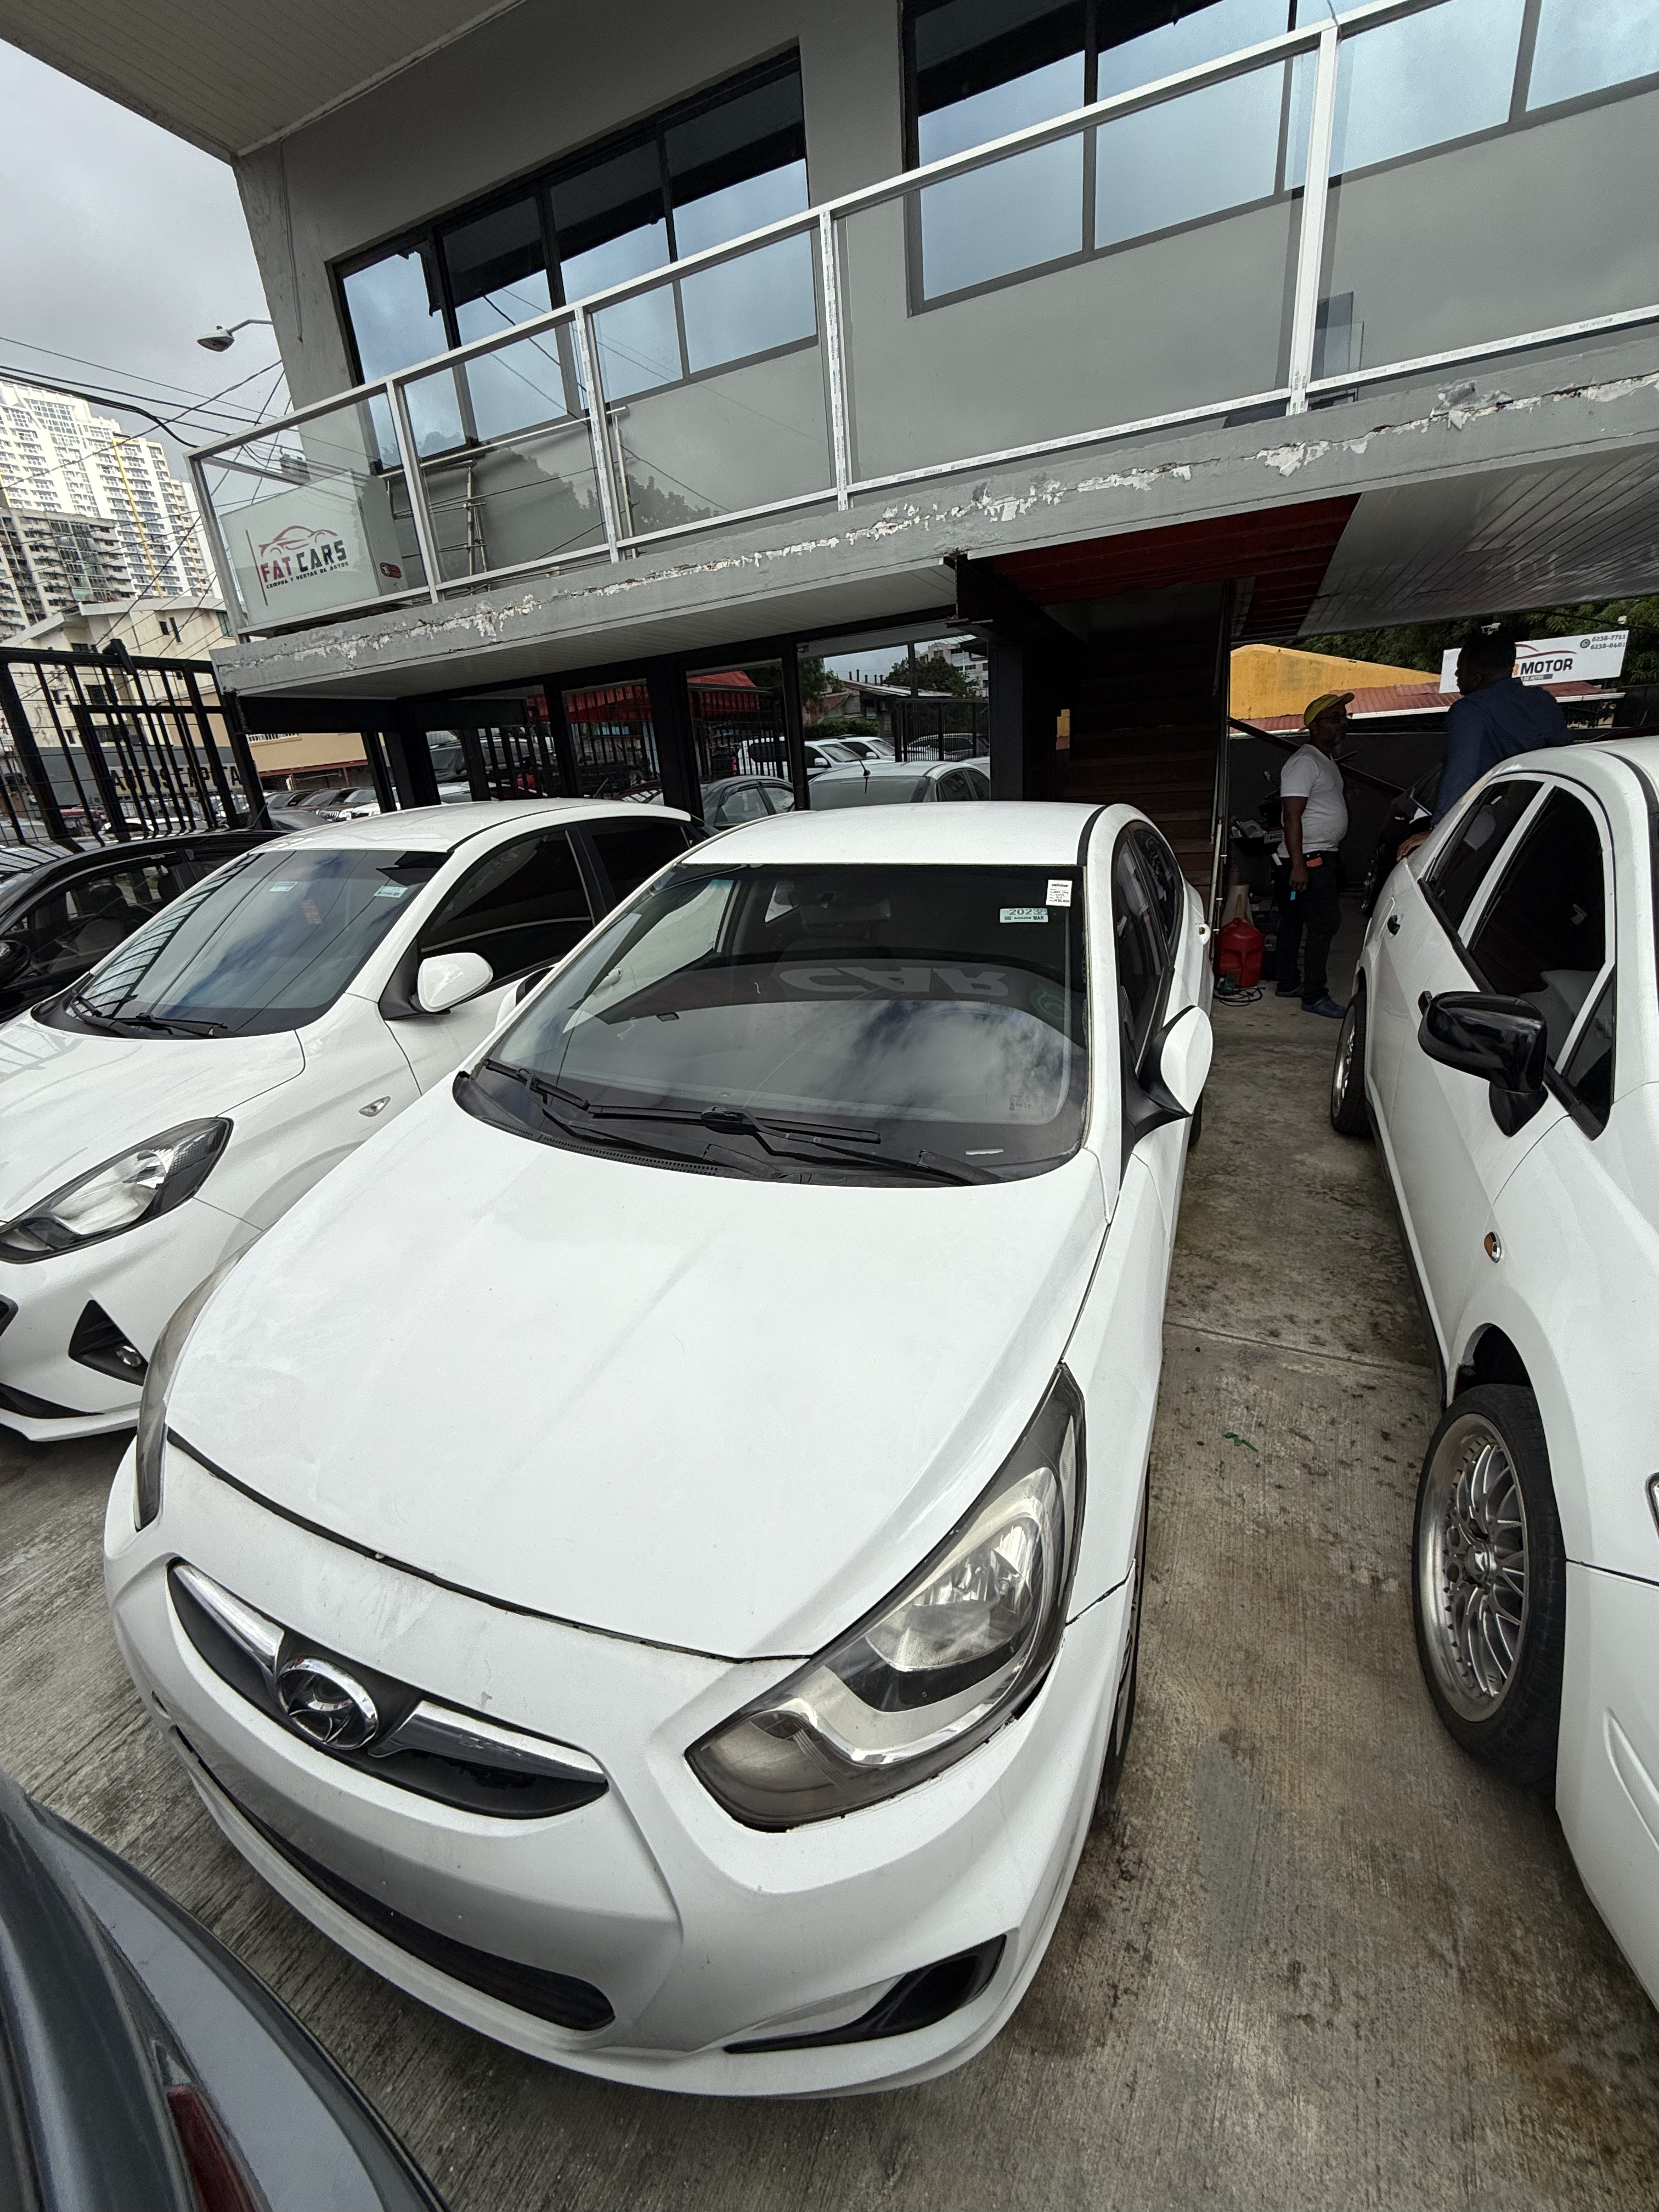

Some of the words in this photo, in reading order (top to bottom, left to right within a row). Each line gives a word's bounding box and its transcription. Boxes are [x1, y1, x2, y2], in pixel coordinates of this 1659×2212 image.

[260, 556, 292, 583] FAT
[296, 540, 347, 573] CARS
[266, 579, 289, 589] COMPRA
[296, 571, 318, 580] VENTAS
[330, 561, 349, 571] AUTOS
[1520, 658, 1573, 675] MOTOR
